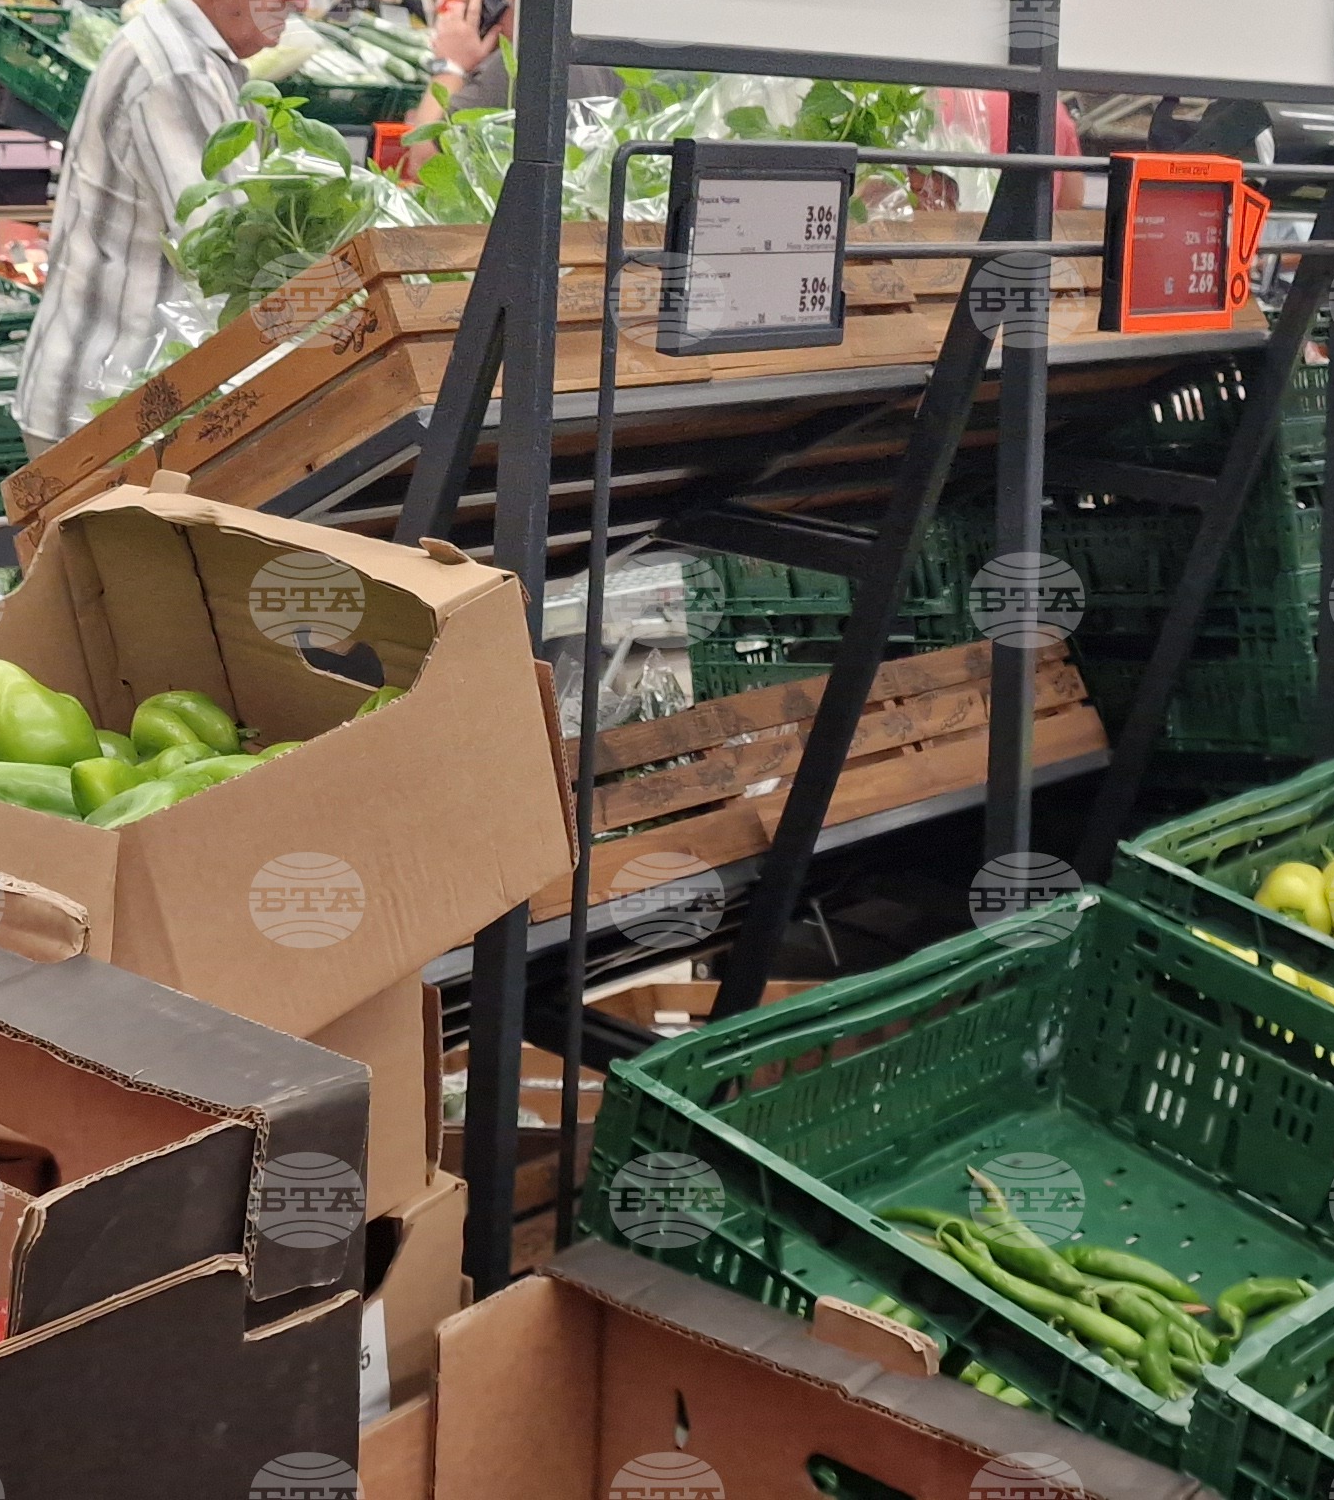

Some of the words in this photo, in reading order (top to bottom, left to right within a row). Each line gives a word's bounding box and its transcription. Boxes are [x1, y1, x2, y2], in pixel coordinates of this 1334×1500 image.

[805, 206, 833, 223] 3.06
[804, 223, 832, 241] 5.99
[799, 277, 827, 294] 3.06
[798, 295, 826, 312] 5.99
